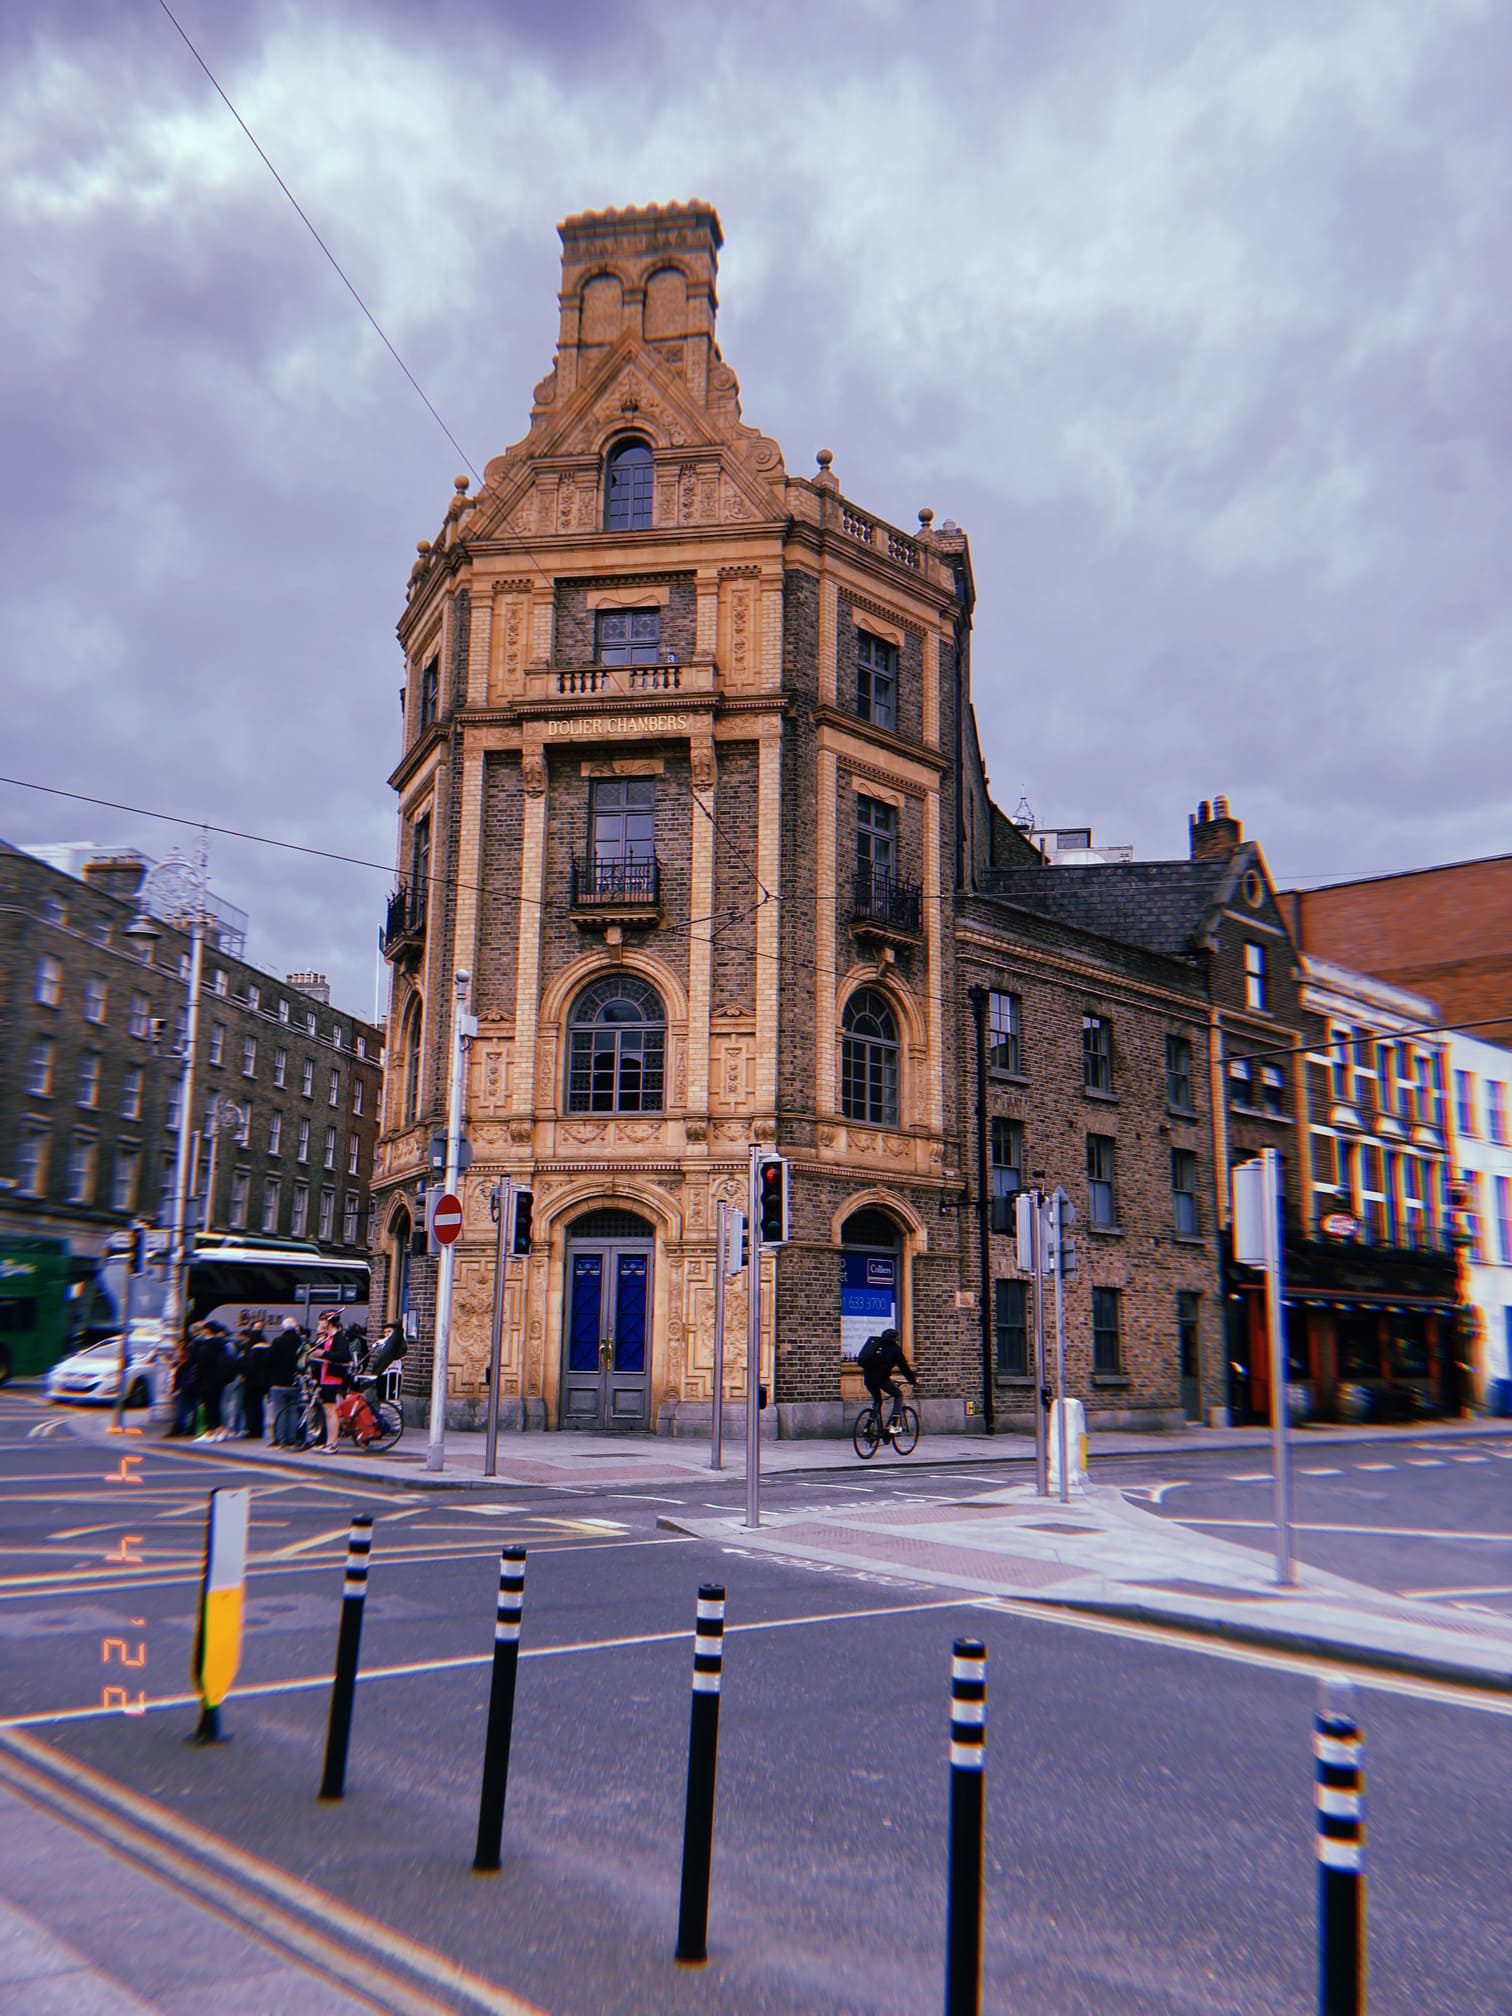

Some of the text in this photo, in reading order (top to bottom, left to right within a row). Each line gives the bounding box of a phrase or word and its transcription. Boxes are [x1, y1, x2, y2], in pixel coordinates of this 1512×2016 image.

[549, 715, 687, 736] D'OLIER CHAMBERS
[849, 1296, 865, 1310] 633
[866, 1297, 886, 1311] 3700
